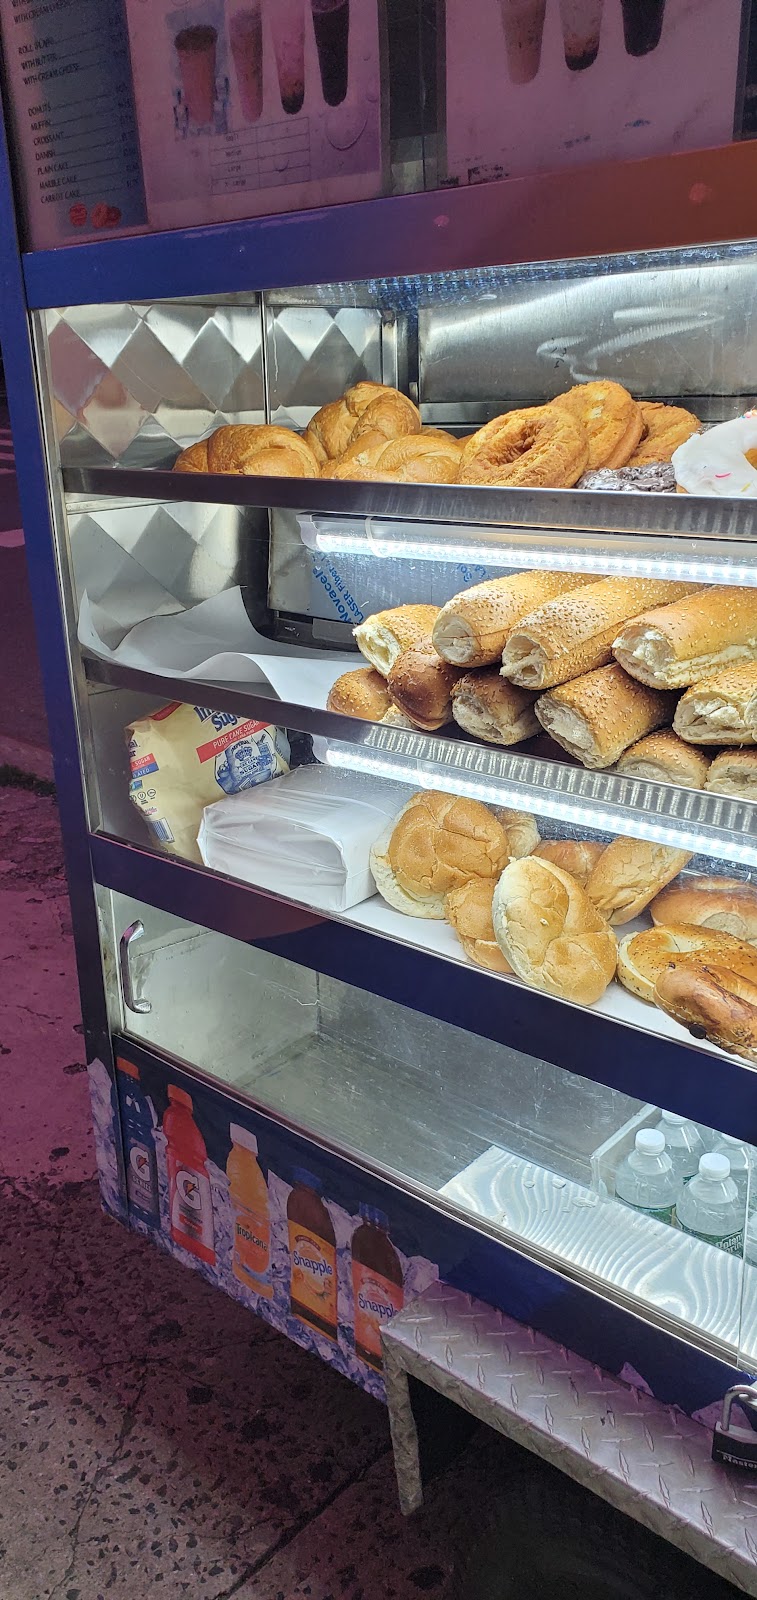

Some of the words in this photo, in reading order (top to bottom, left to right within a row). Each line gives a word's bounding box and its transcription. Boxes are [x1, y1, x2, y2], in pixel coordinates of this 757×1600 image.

[18, 44, 34, 55] ROLL
[21, 59, 36, 70] WITH
[22, 75, 38, 86] WITH
[28, 102, 52, 117] DONUTS
[30, 119, 51, 131] MUFFIN
[33, 131, 64, 146] CROISSANT
[35, 149, 56, 161] DANISH
[37, 165, 54, 175] PLAIN
[54, 162, 69, 172] CAKE
[39, 178, 61, 190] MARBLE
[61, 175, 78, 186] CAKE
[40, 192, 64, 204] CARROT
[64, 189, 81, 199] CAKE
[343, 589, 365, 624] LASER
[211, 711, 241, 733] Sug
[213, 736, 229, 749] PURE
[229, 729, 244, 740] CANE
[134, 756, 151, 767] SUGAR
[239, 763, 260, 776] SUGAR
[132, 1175, 152, 1192] SERIES
[235, 1222, 269, 1252] Tropicana
[292, 1250, 333, 1277] Snapple
